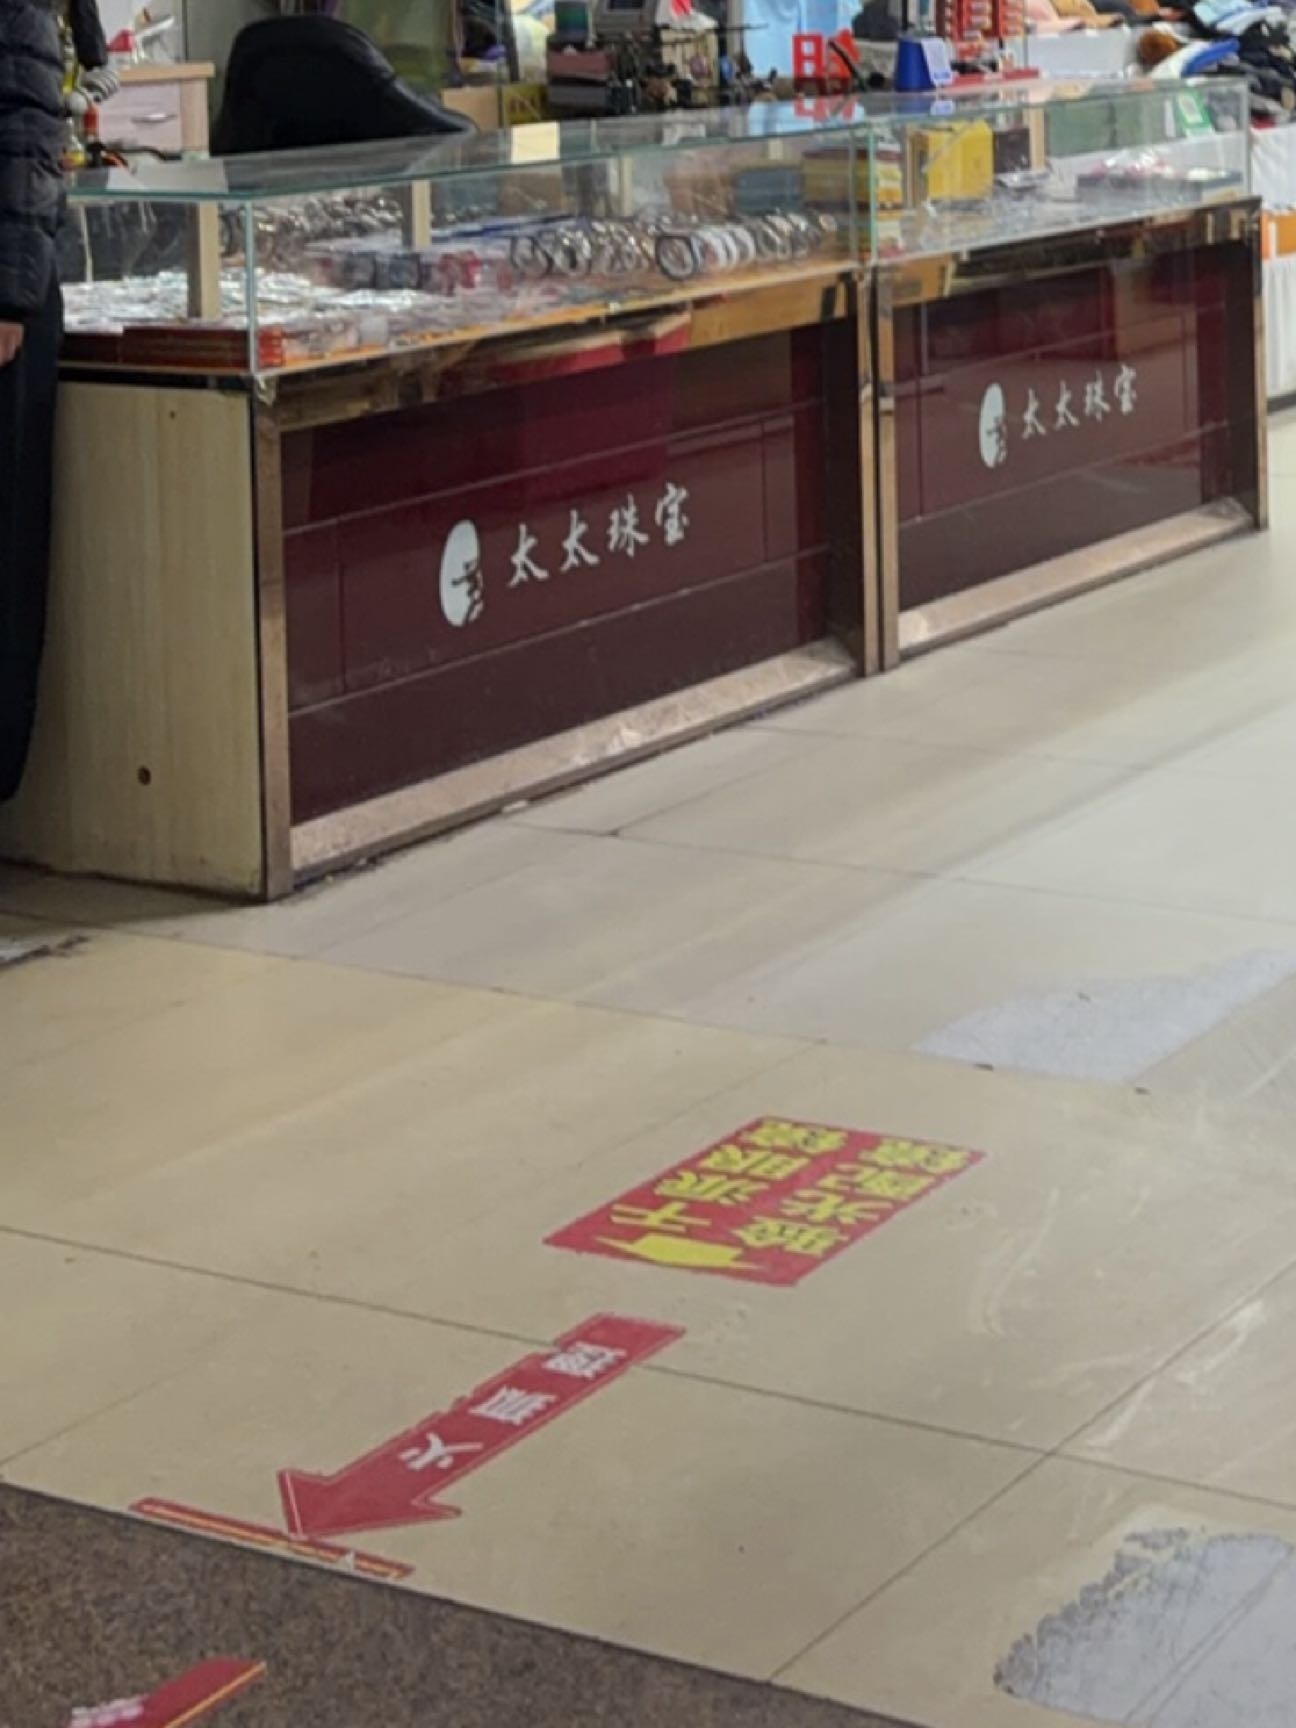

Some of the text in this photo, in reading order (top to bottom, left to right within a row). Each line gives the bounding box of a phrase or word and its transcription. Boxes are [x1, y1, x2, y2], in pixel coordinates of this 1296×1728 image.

[1021, 364, 1137, 441] 太太珠宝
[507, 480, 690, 589] 太太珠宝
